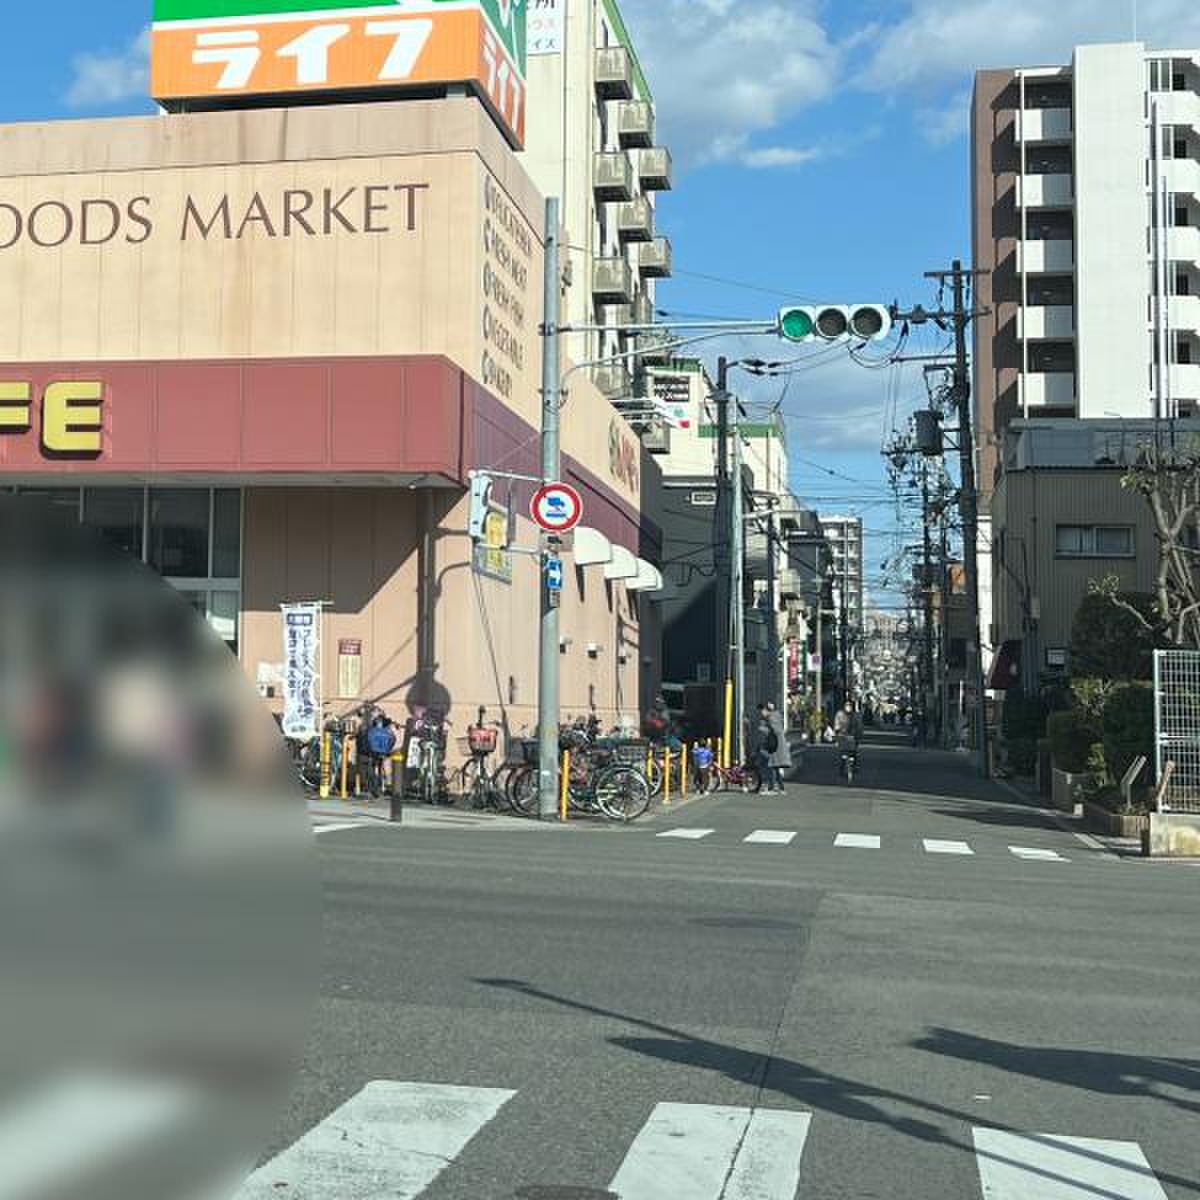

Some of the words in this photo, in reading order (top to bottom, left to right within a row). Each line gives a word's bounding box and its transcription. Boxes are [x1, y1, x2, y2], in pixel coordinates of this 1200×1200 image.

[191, 18, 433, 90] ライフ
[179, 183, 430, 241] MARKET
